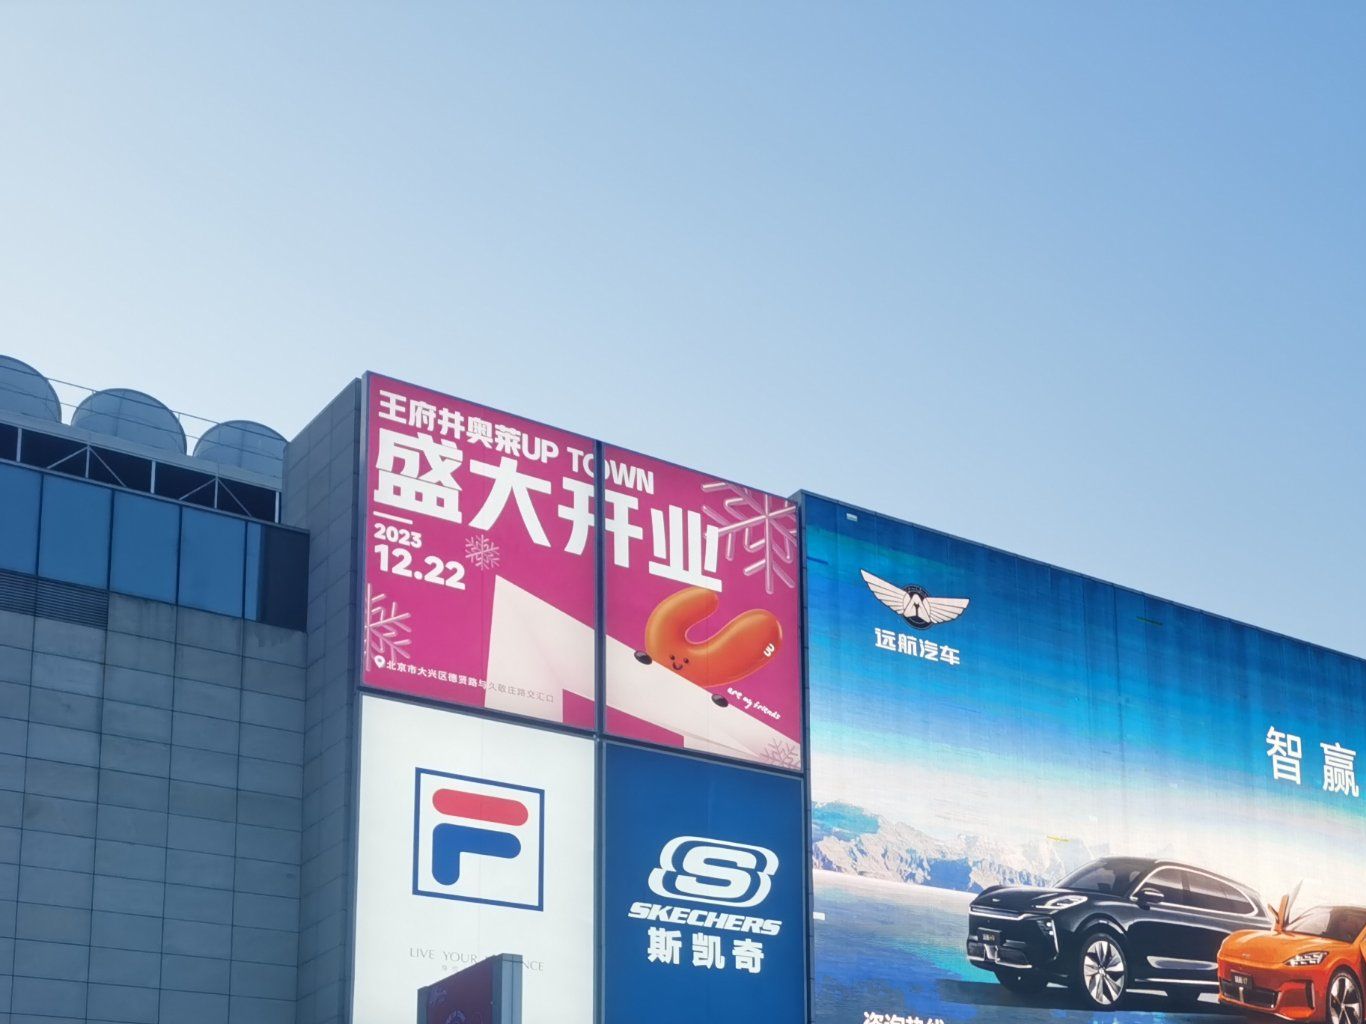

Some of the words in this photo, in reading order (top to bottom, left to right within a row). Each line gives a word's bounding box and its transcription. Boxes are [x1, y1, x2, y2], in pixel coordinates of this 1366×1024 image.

[567, 446, 654, 495] TOWN
[374, 428, 722, 592] 盛大开业
[374, 523, 422, 549] 2023
[374, 544, 466, 590] 12.22
[874, 628, 961, 666] 远航汽车
[753, 701, 781, 720] friends
[628, 901, 783, 936] SKECHERS
[409, 947, 436, 960] LIVE
[441, 950, 478, 963] YOUR
[647, 926, 765, 974] 斯凯奇
